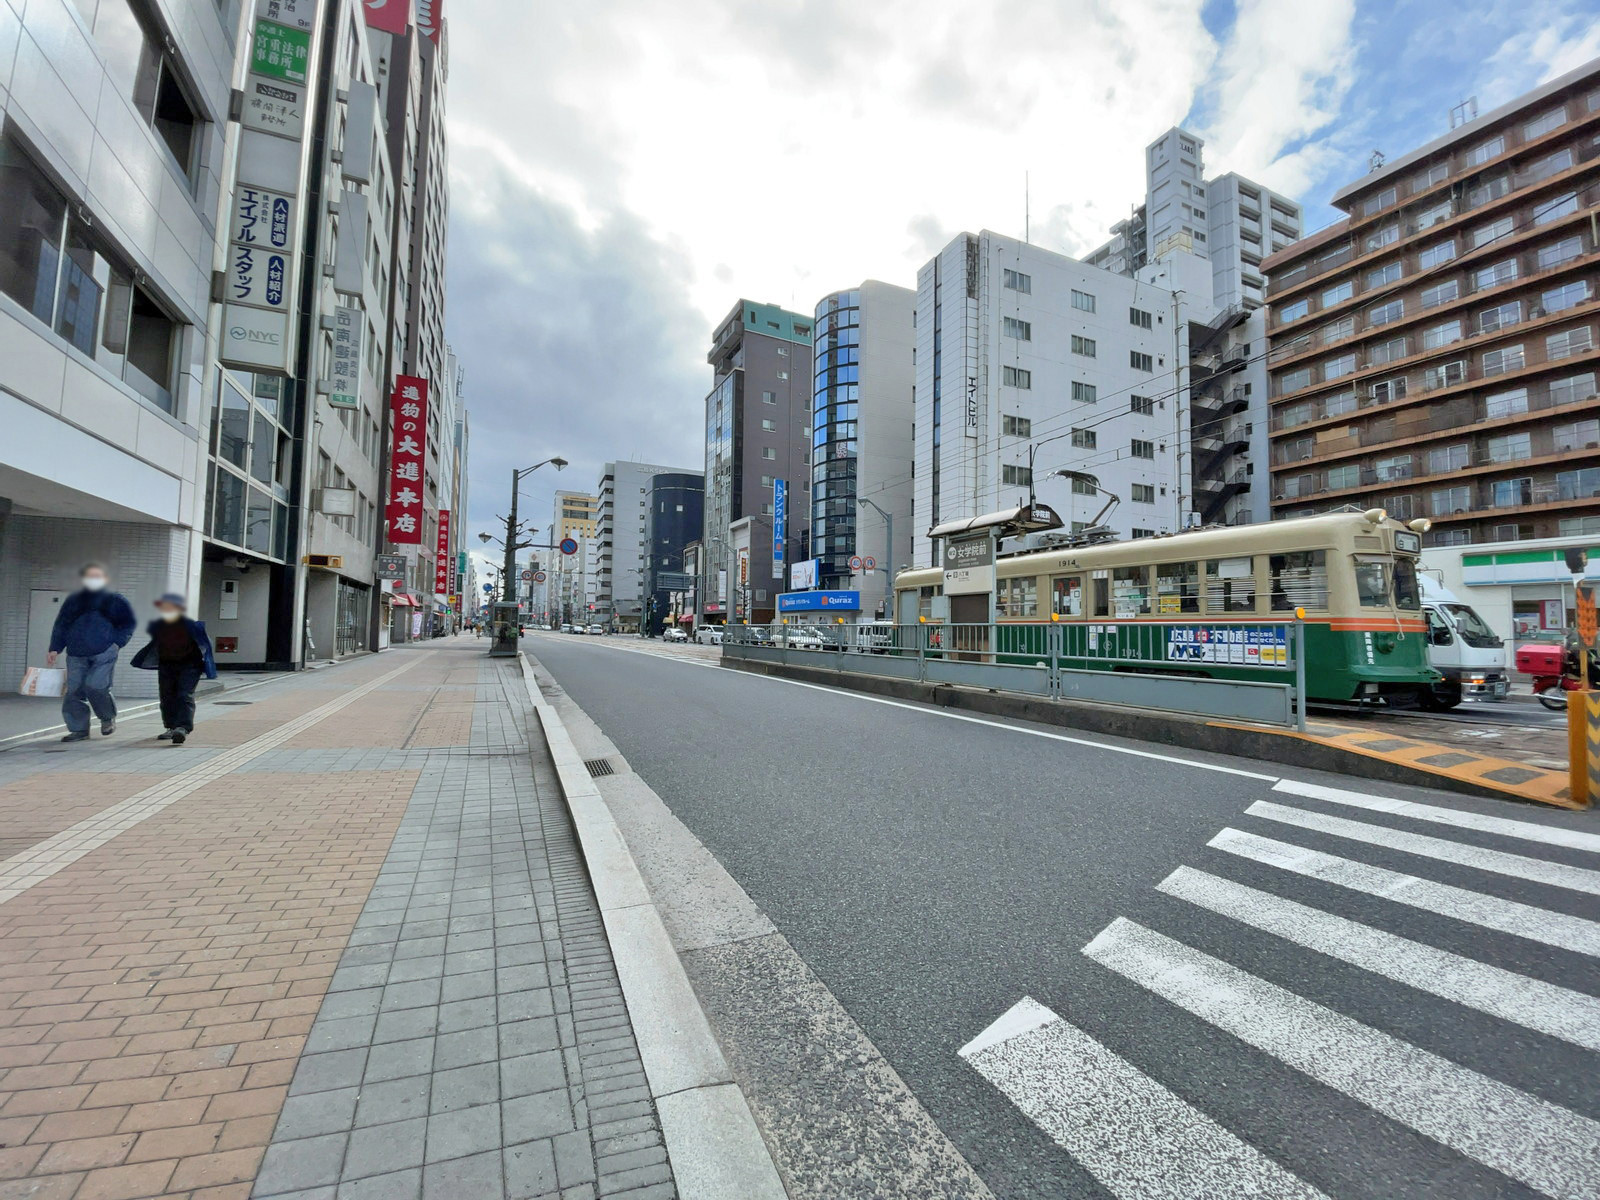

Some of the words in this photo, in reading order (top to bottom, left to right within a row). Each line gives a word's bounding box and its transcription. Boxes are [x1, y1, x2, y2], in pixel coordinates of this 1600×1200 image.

[268, 260, 283, 302] 人材紹介
[248, 329, 279, 343] NYC
[393, 386, 422, 534] 進物の大進本店
[775, 484, 784, 540] トランクルーム
[958, 545, 987, 558] 女学院前
[829, 597, 852, 605] Quraz
